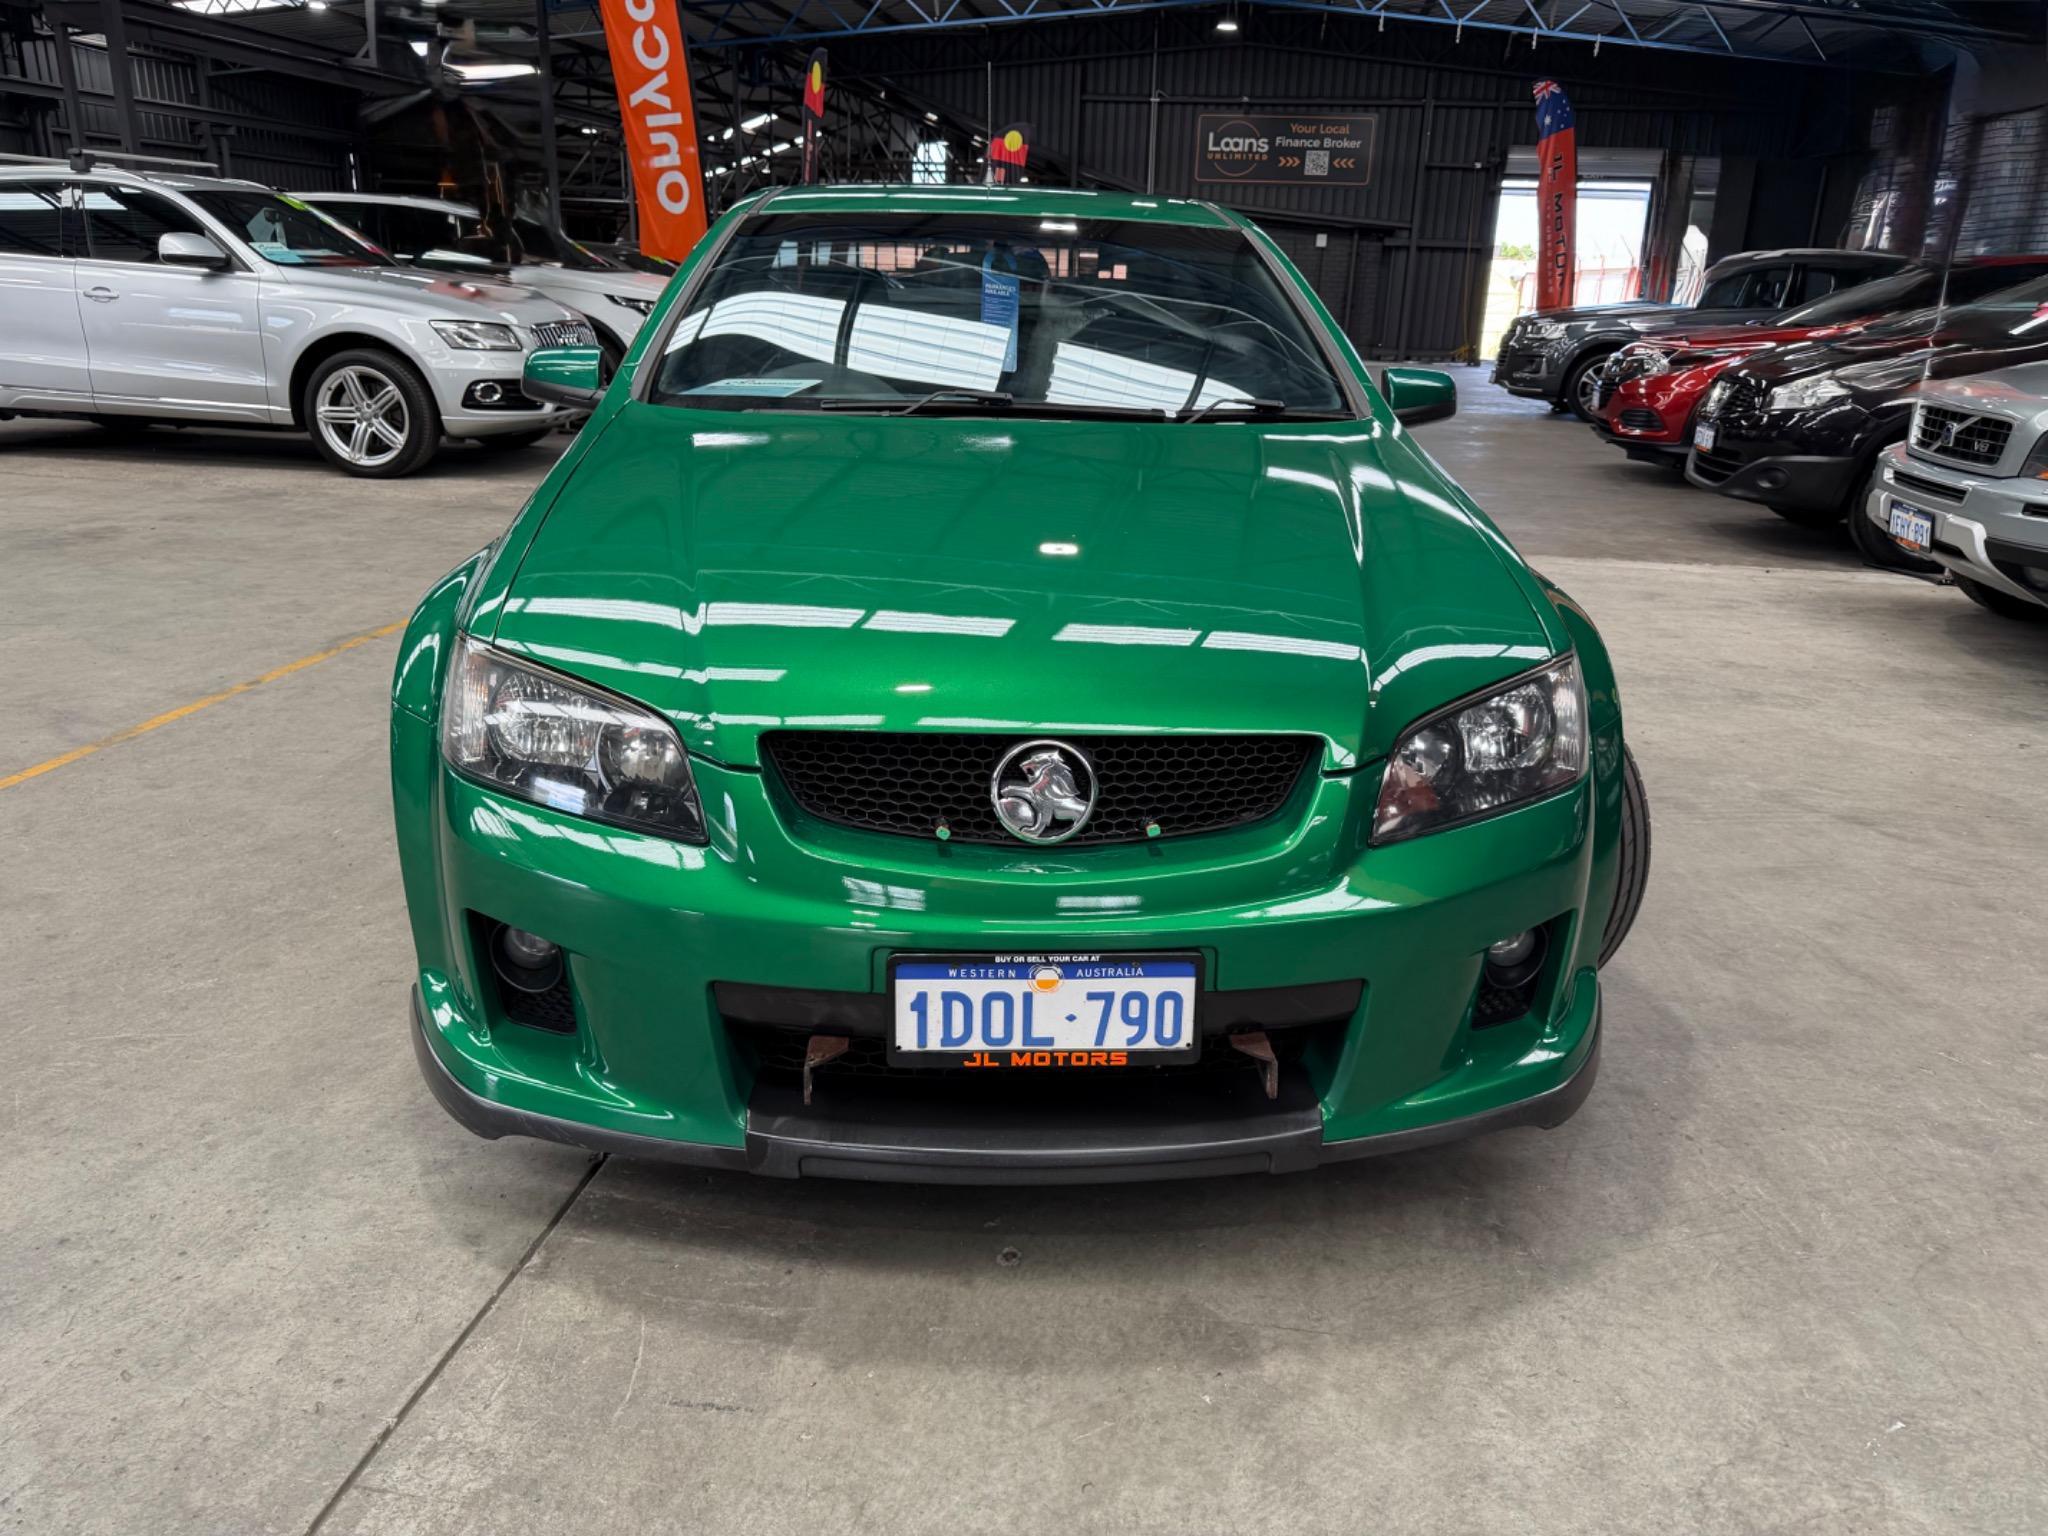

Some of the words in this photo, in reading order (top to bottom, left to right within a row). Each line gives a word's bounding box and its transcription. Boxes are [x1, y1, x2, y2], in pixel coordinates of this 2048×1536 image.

[1290, 123, 1317, 134] Your
[1320, 123, 1350, 135] Local
[1208, 131, 1269, 152] Loans
[1275, 135, 1320, 148] Finance
[1323, 137, 1362, 149] Broker
[948, 968, 1017, 979] WESTERN
[1076, 967, 1144, 978] AUSTRALIA
[963, 1052, 999, 1067] JL
[1011, 1051, 1128, 1067] MOTORS
